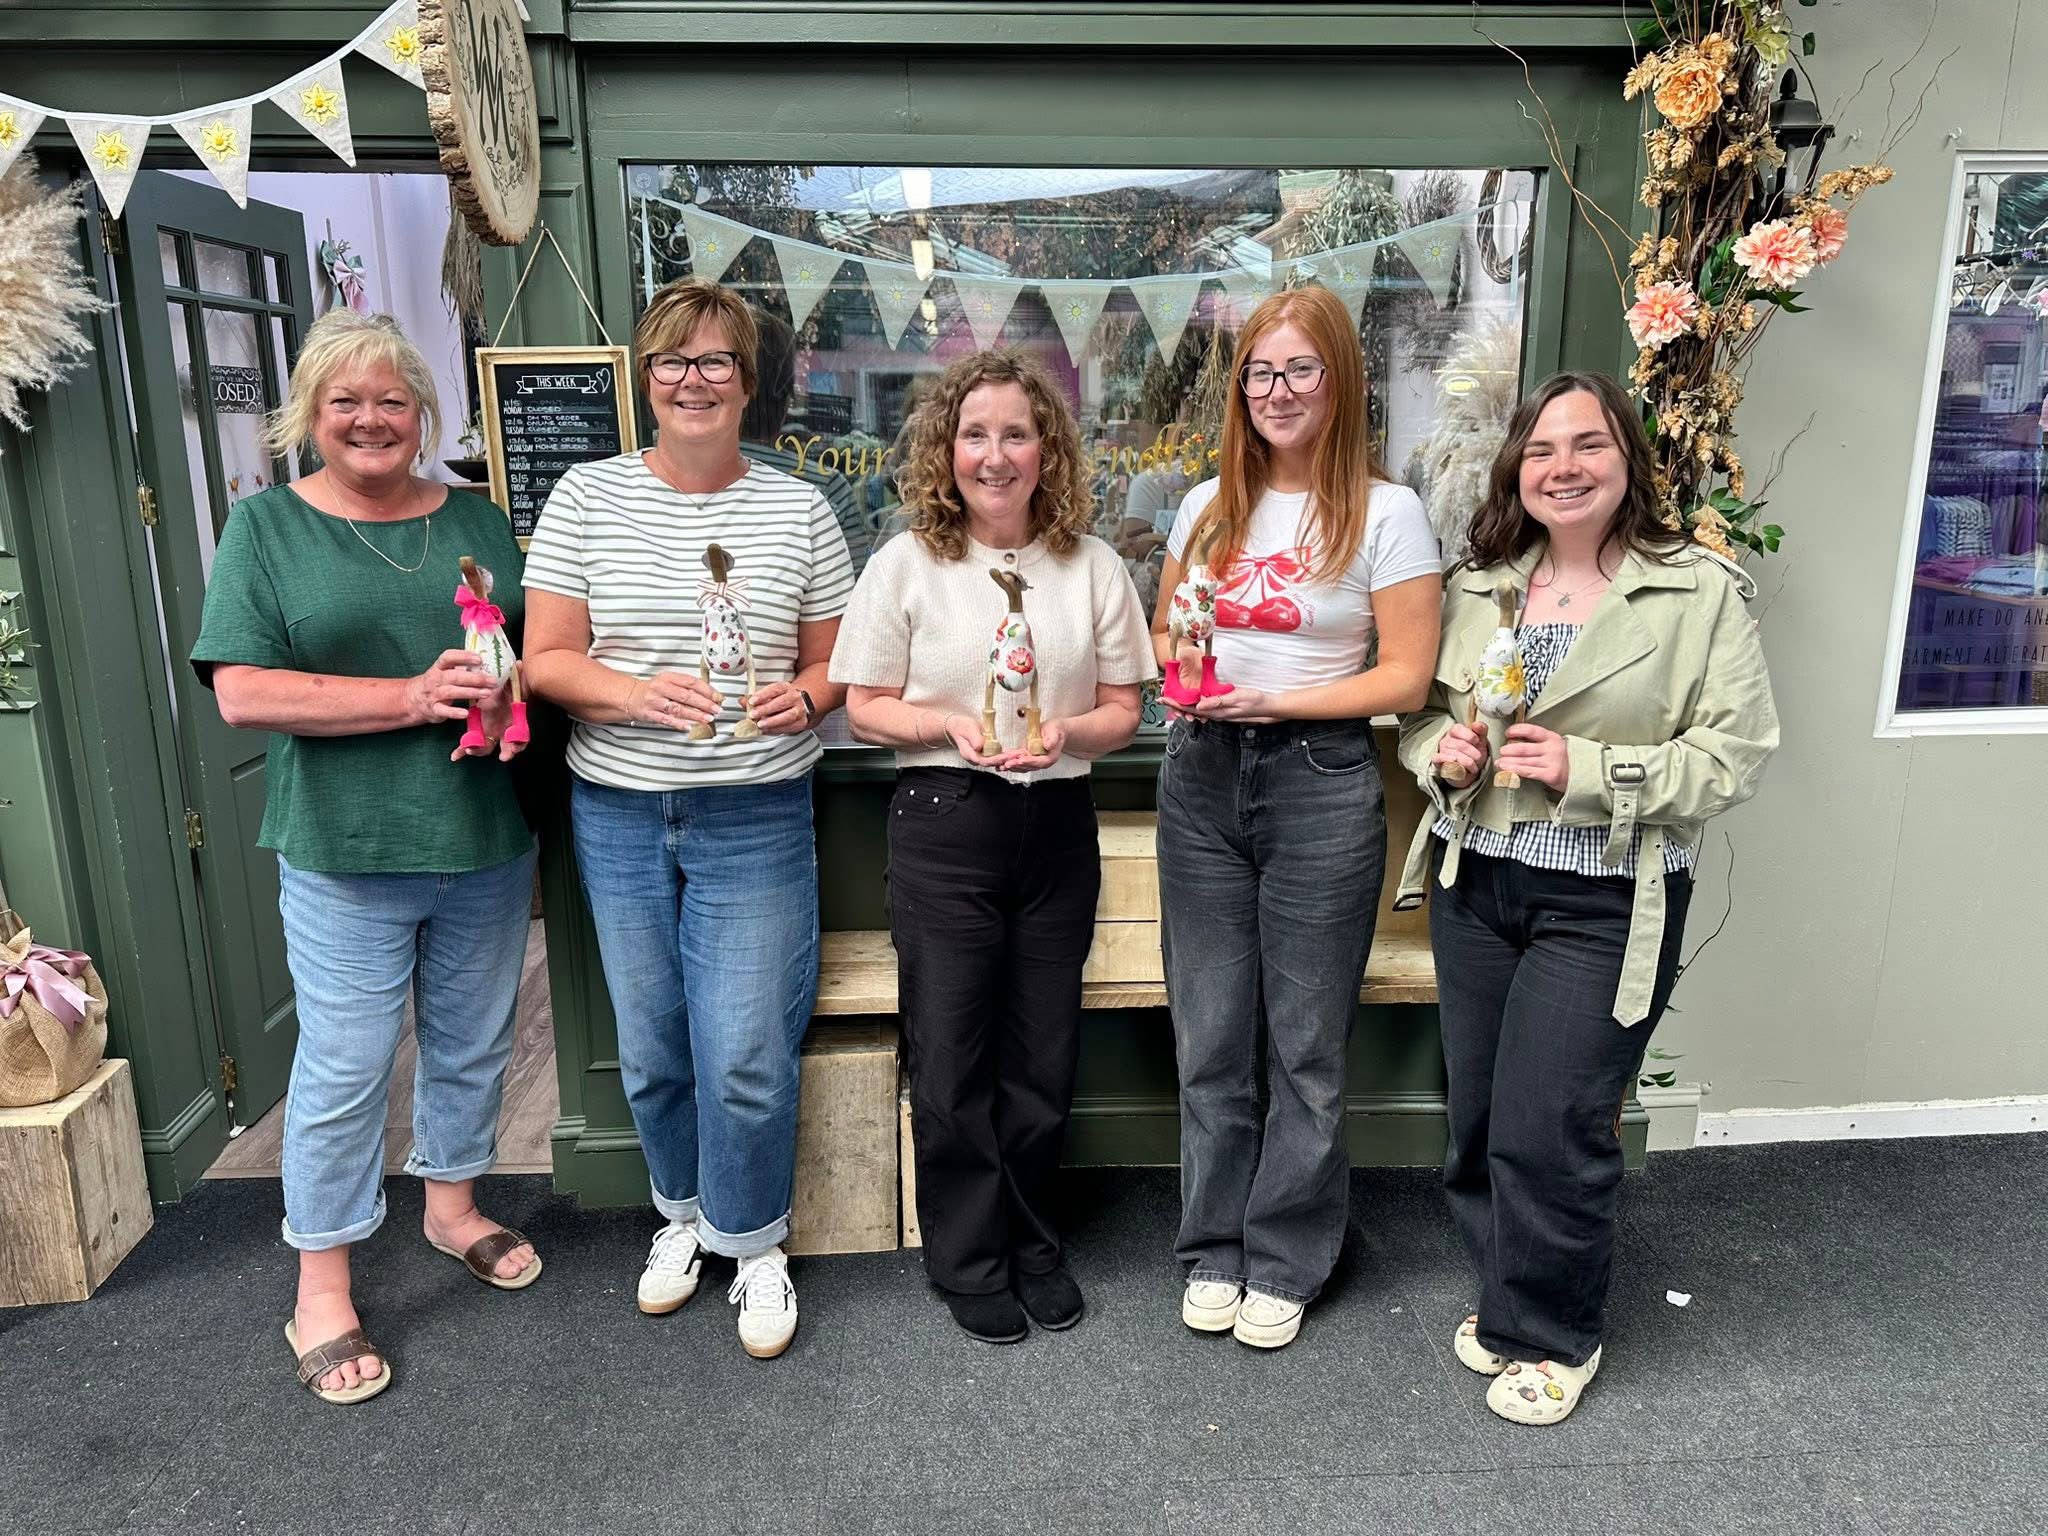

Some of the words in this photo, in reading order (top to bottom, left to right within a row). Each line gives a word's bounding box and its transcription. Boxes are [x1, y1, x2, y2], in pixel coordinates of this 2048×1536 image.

[536, 377, 552, 388] THIS
[554, 377, 577, 388] WEEK
[214, 382, 256, 402] OSED
[503, 406, 523, 415] MONDAY
[527, 406, 562, 414] CLOSED
[505, 426, 525, 435] TUESDAY
[527, 426, 561, 434] CLOSED
[506, 444, 534, 453] WEDNESDAY
[510, 472, 529, 484] 8/5
[511, 484, 526, 492] FRIDAY
[512, 501, 534, 509] SATURDAY
[514, 520, 532, 528] SUNDAY
[1944, 608, 1985, 626] MAKE
[1994, 608, 2014, 626] DO
